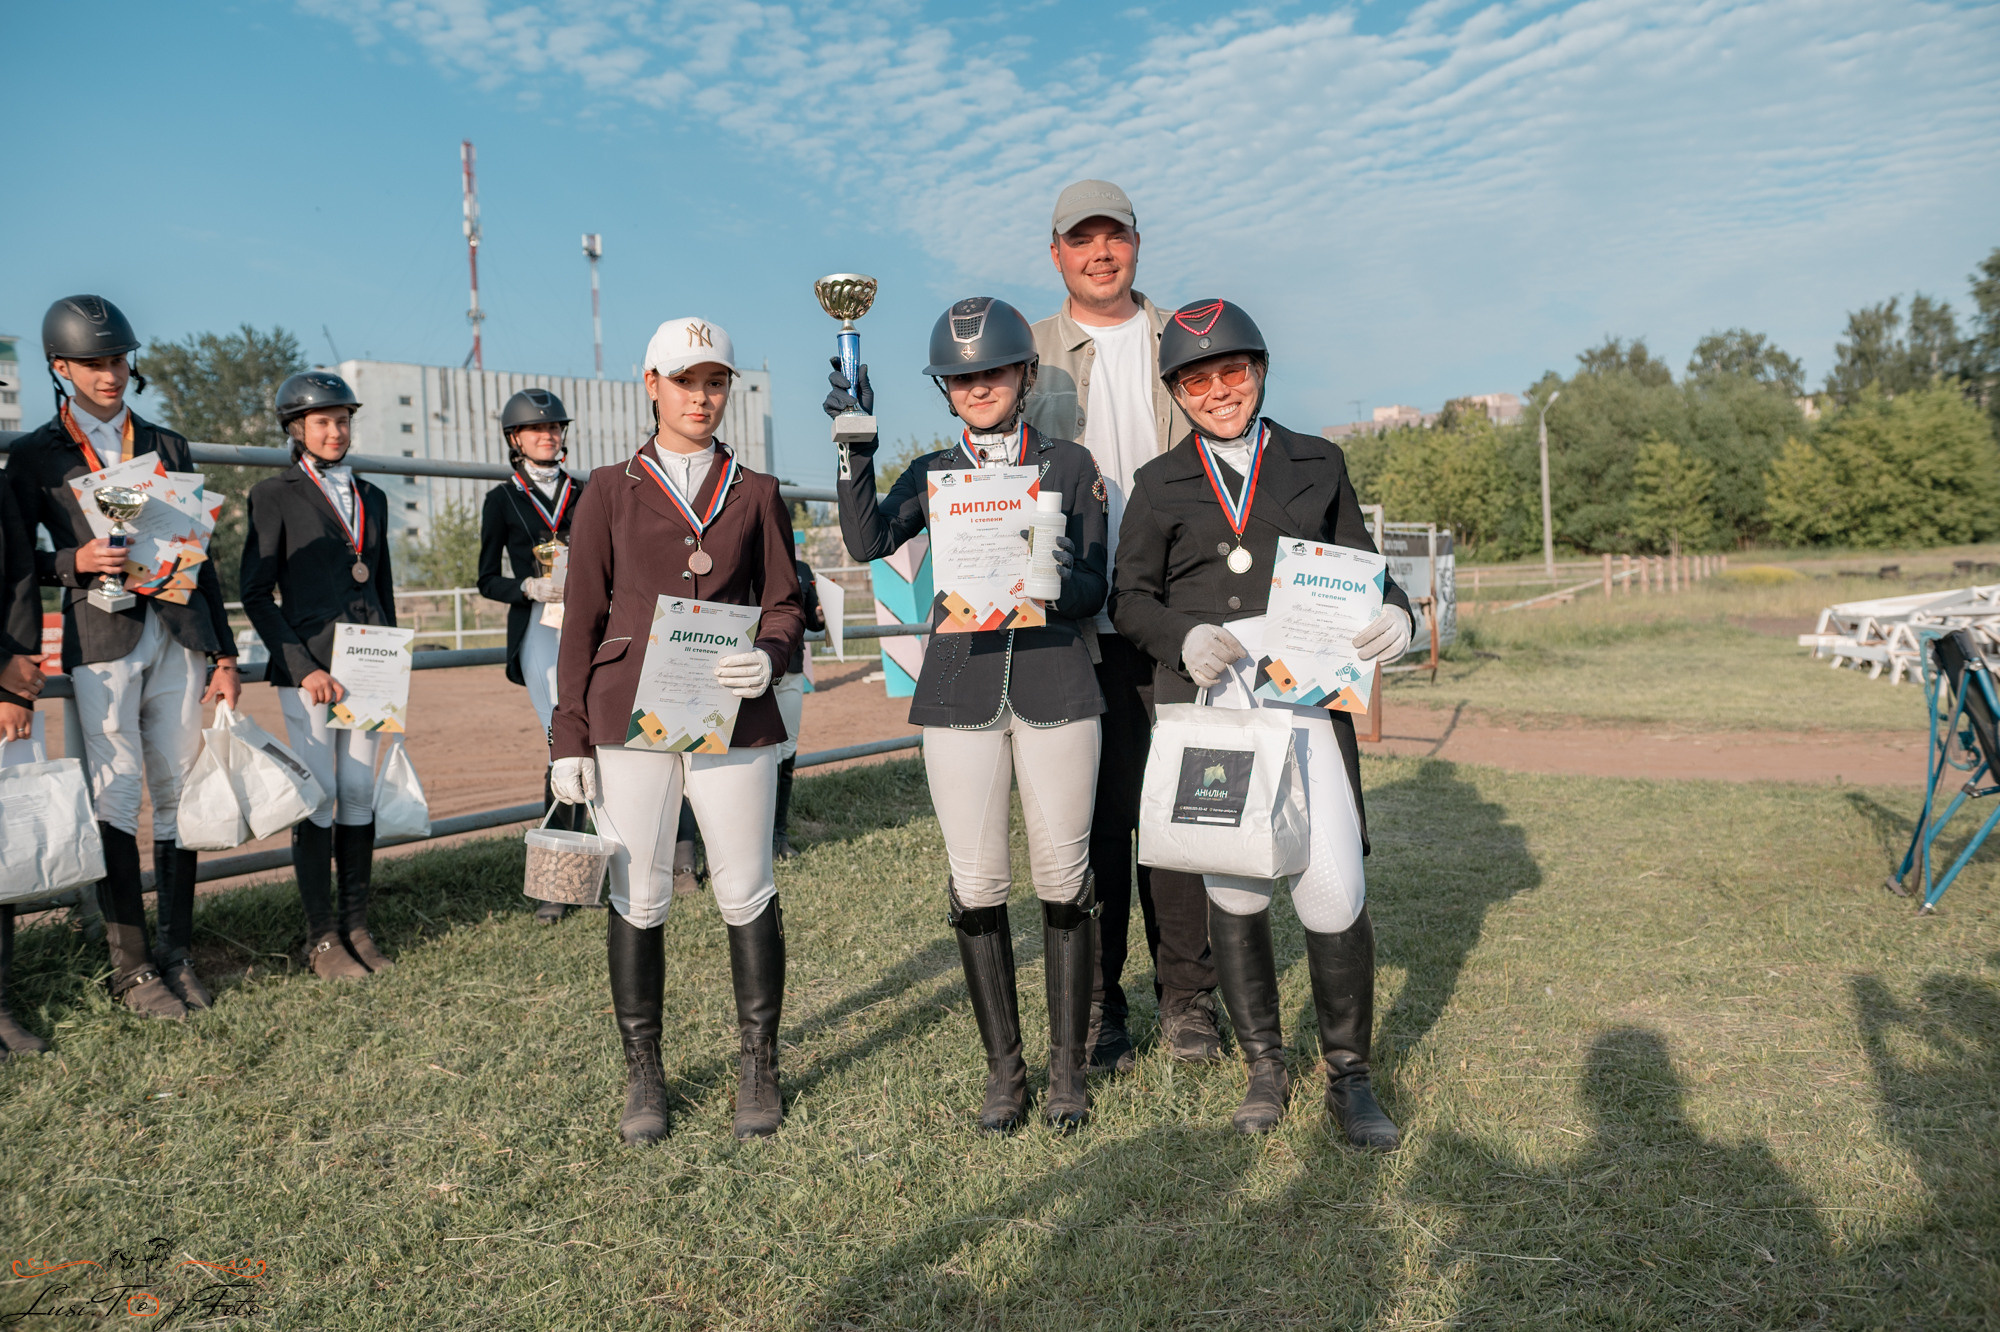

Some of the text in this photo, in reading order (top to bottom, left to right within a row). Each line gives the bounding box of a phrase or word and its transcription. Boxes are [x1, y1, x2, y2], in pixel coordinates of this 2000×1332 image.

[686, 323, 713, 348] NY
[949, 499, 1022, 516] ДИПЛОМ
[1293, 572, 1367, 595] ДИПЛОМ
[1317, 592, 1347, 602] степени
[669, 630, 739, 647] ДИПЛОМ
[346, 646, 398, 657] ДИПЛОМ
[692, 647, 719, 655] степени
[1194, 788, 1229, 799] АНИЛИН
